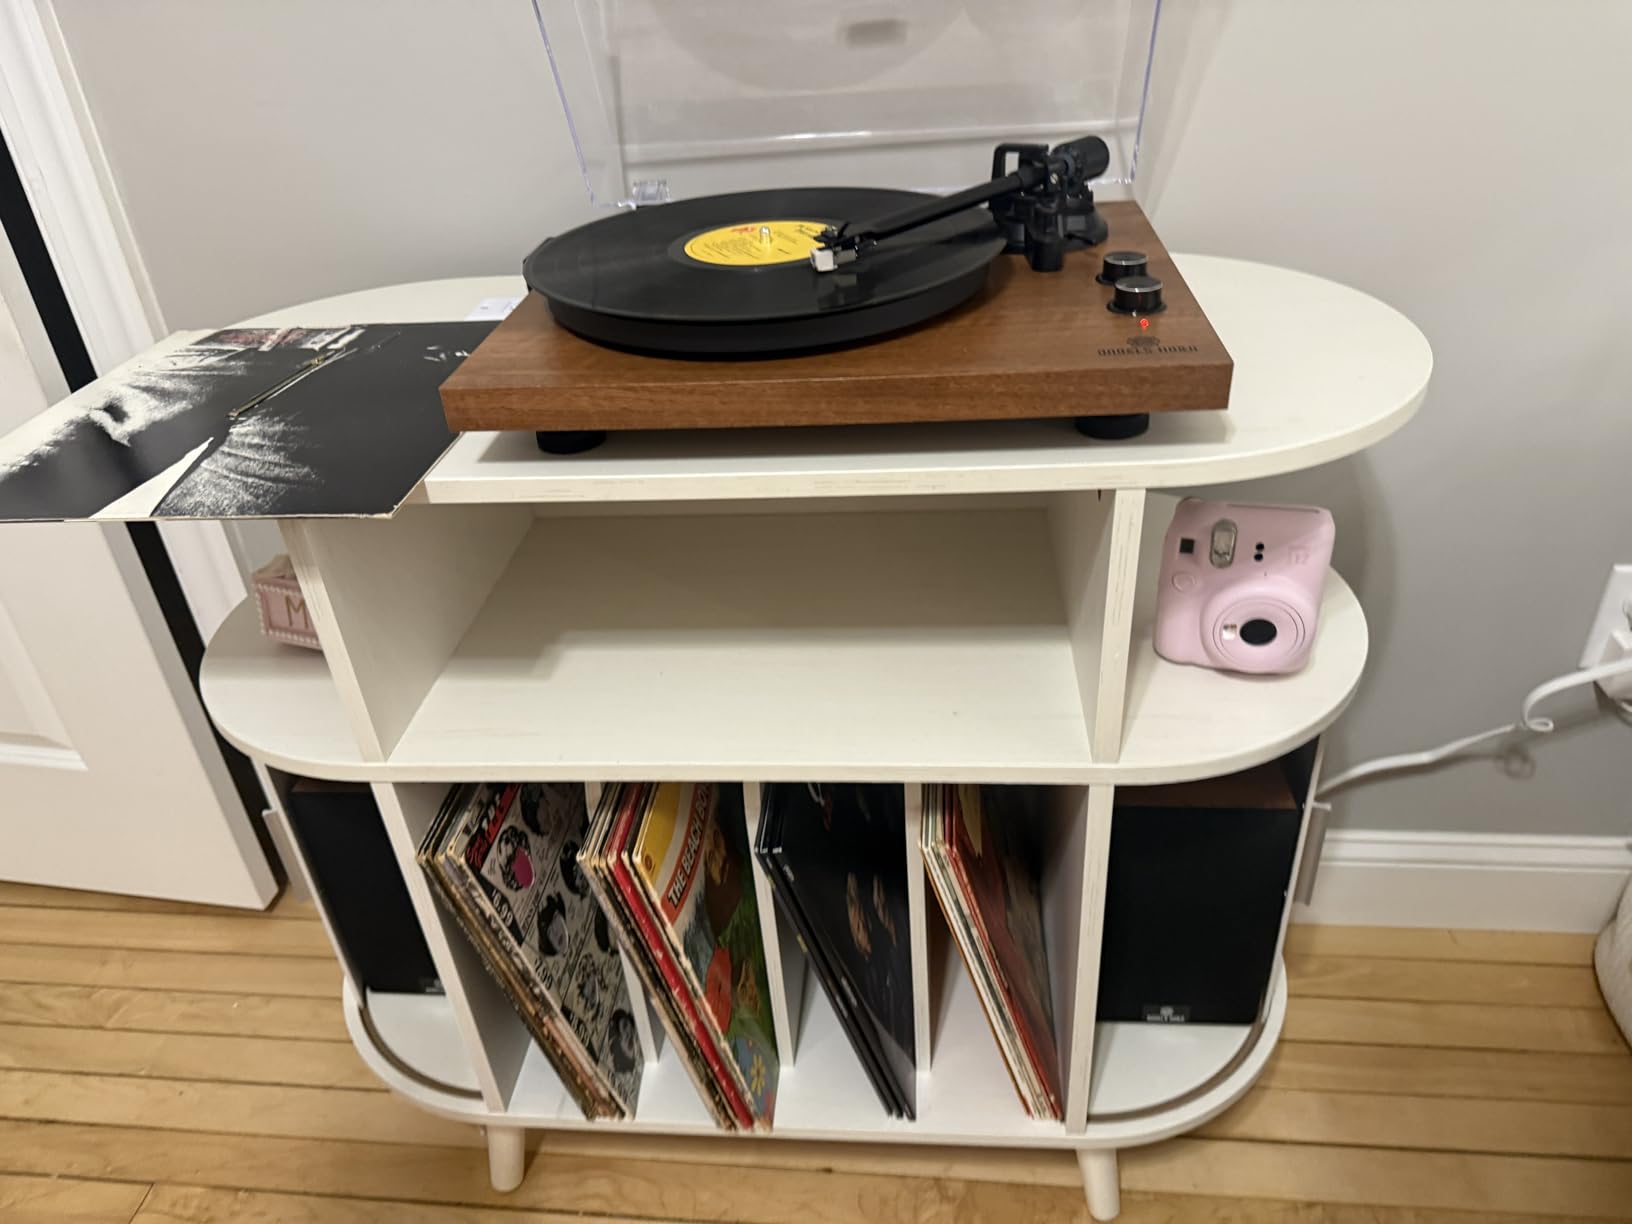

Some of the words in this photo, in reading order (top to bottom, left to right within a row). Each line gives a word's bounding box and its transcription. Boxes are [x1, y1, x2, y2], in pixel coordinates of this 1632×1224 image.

[284, 594, 308, 629] M
[667, 868, 687, 908] THE
[682, 815, 703, 877] BEACH
